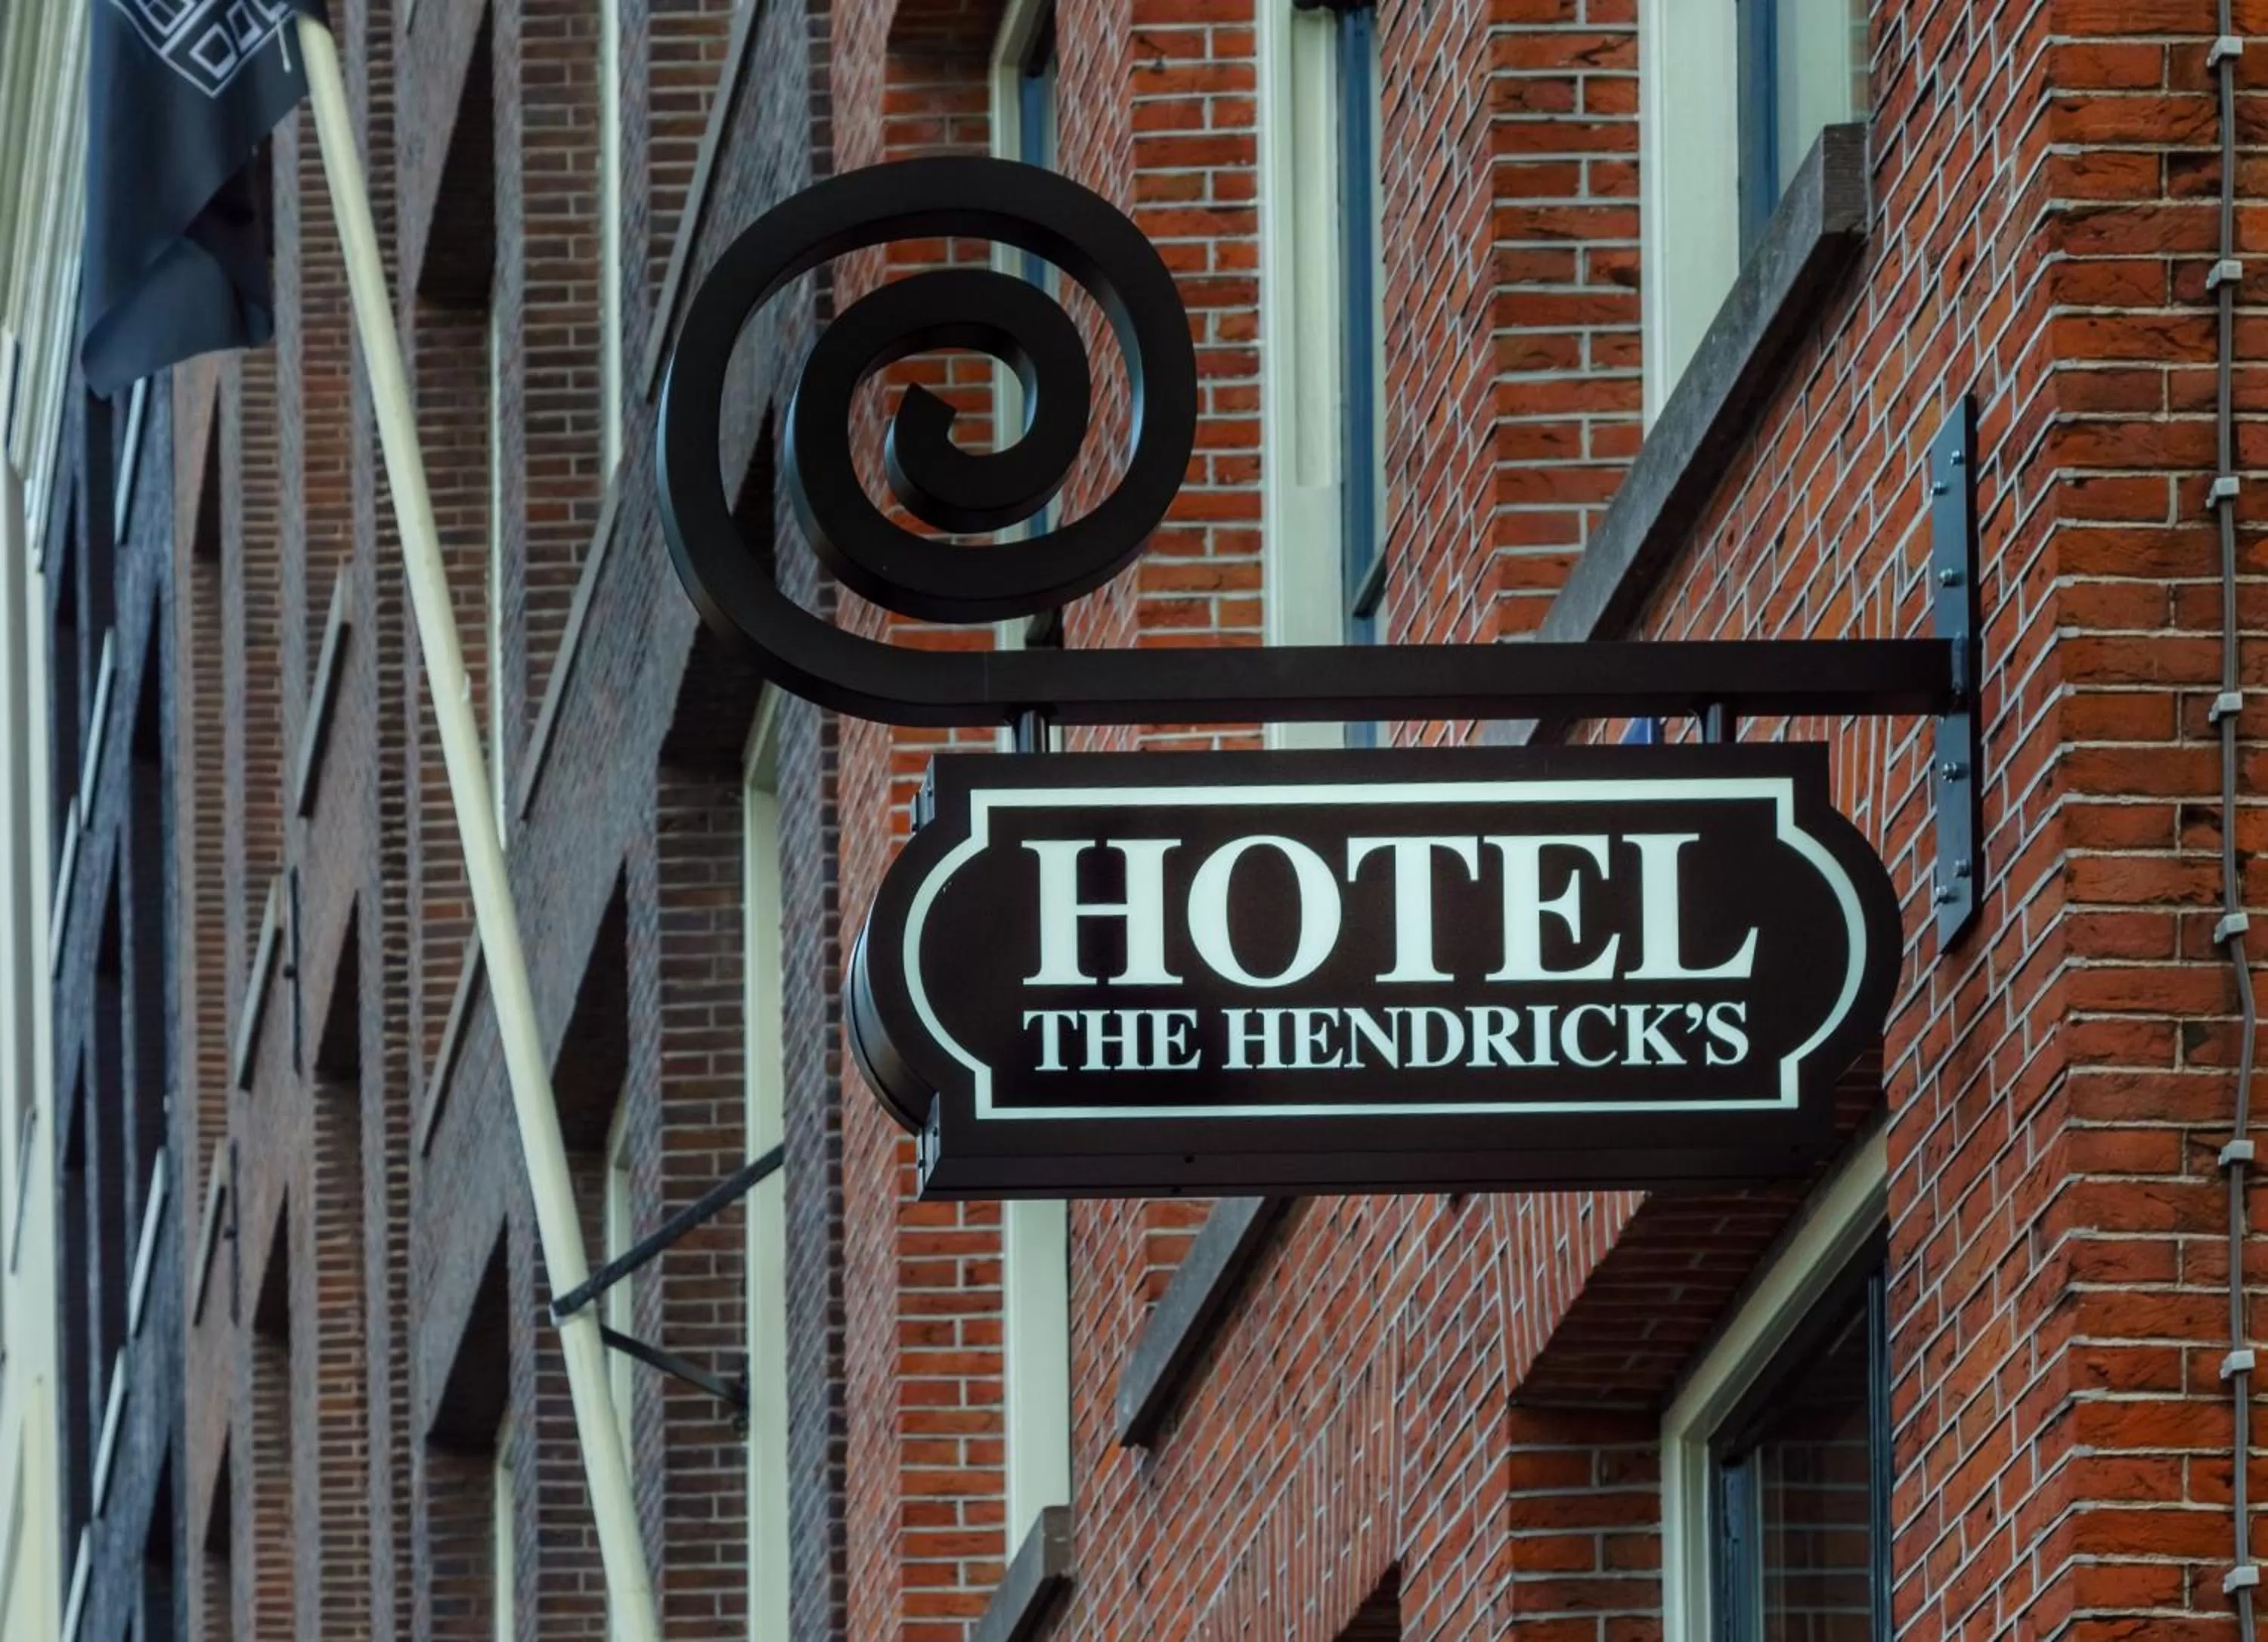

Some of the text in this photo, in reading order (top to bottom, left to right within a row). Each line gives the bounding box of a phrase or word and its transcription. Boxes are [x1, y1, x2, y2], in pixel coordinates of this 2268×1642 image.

[1022, 834, 1758, 988] HOTEL
[1023, 1001, 1749, 1071] THE HENDRICK'S
